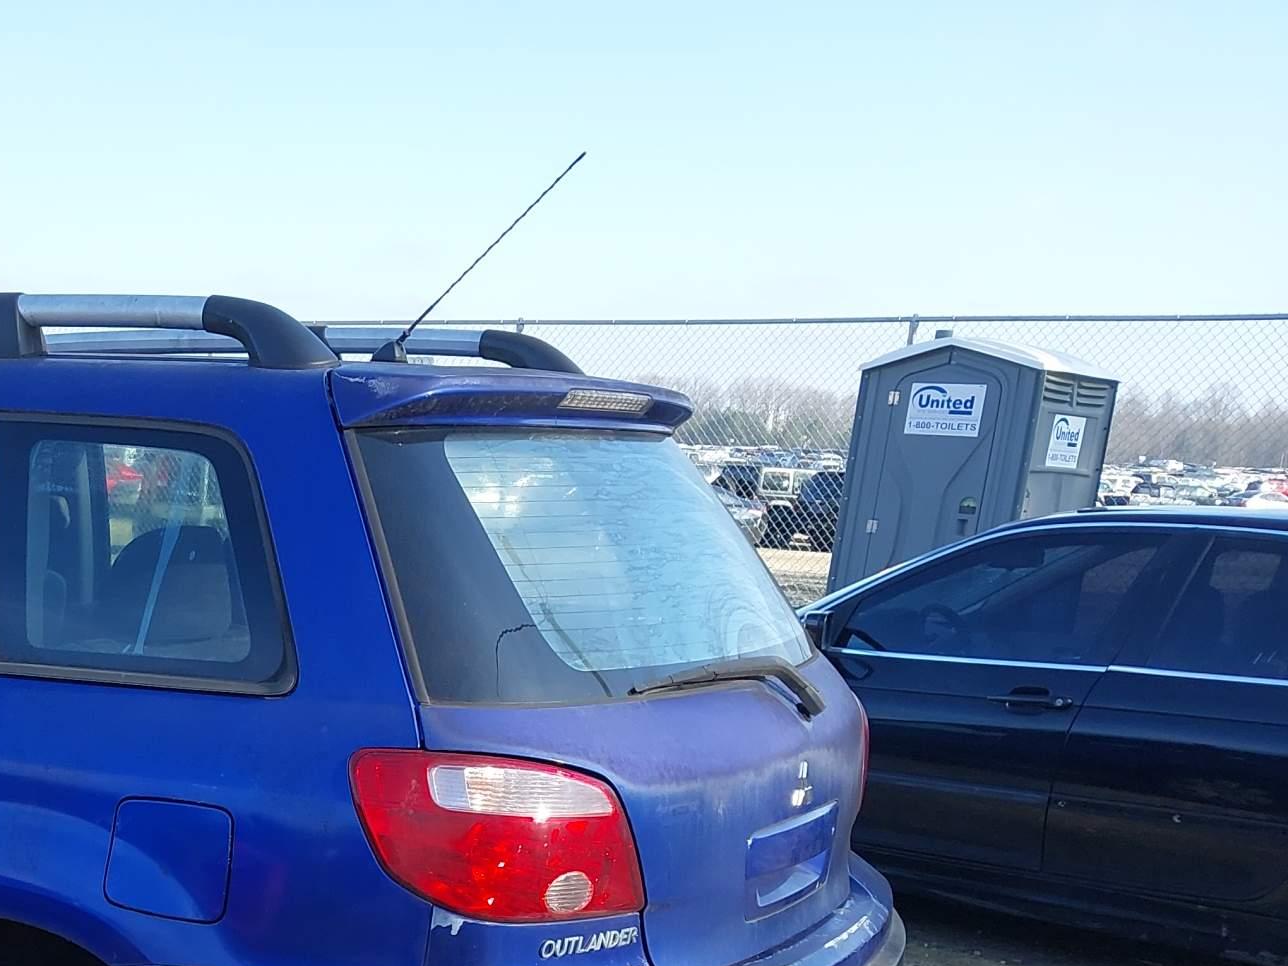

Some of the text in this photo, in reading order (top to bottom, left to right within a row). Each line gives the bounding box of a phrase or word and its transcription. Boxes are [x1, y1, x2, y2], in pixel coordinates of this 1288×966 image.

[918, 393, 976, 410] United
[907, 421, 978, 432] 1-800-TOILETS
[1055, 425, 1081, 442] United
[539, 926, 639, 960] OUTLANDER
